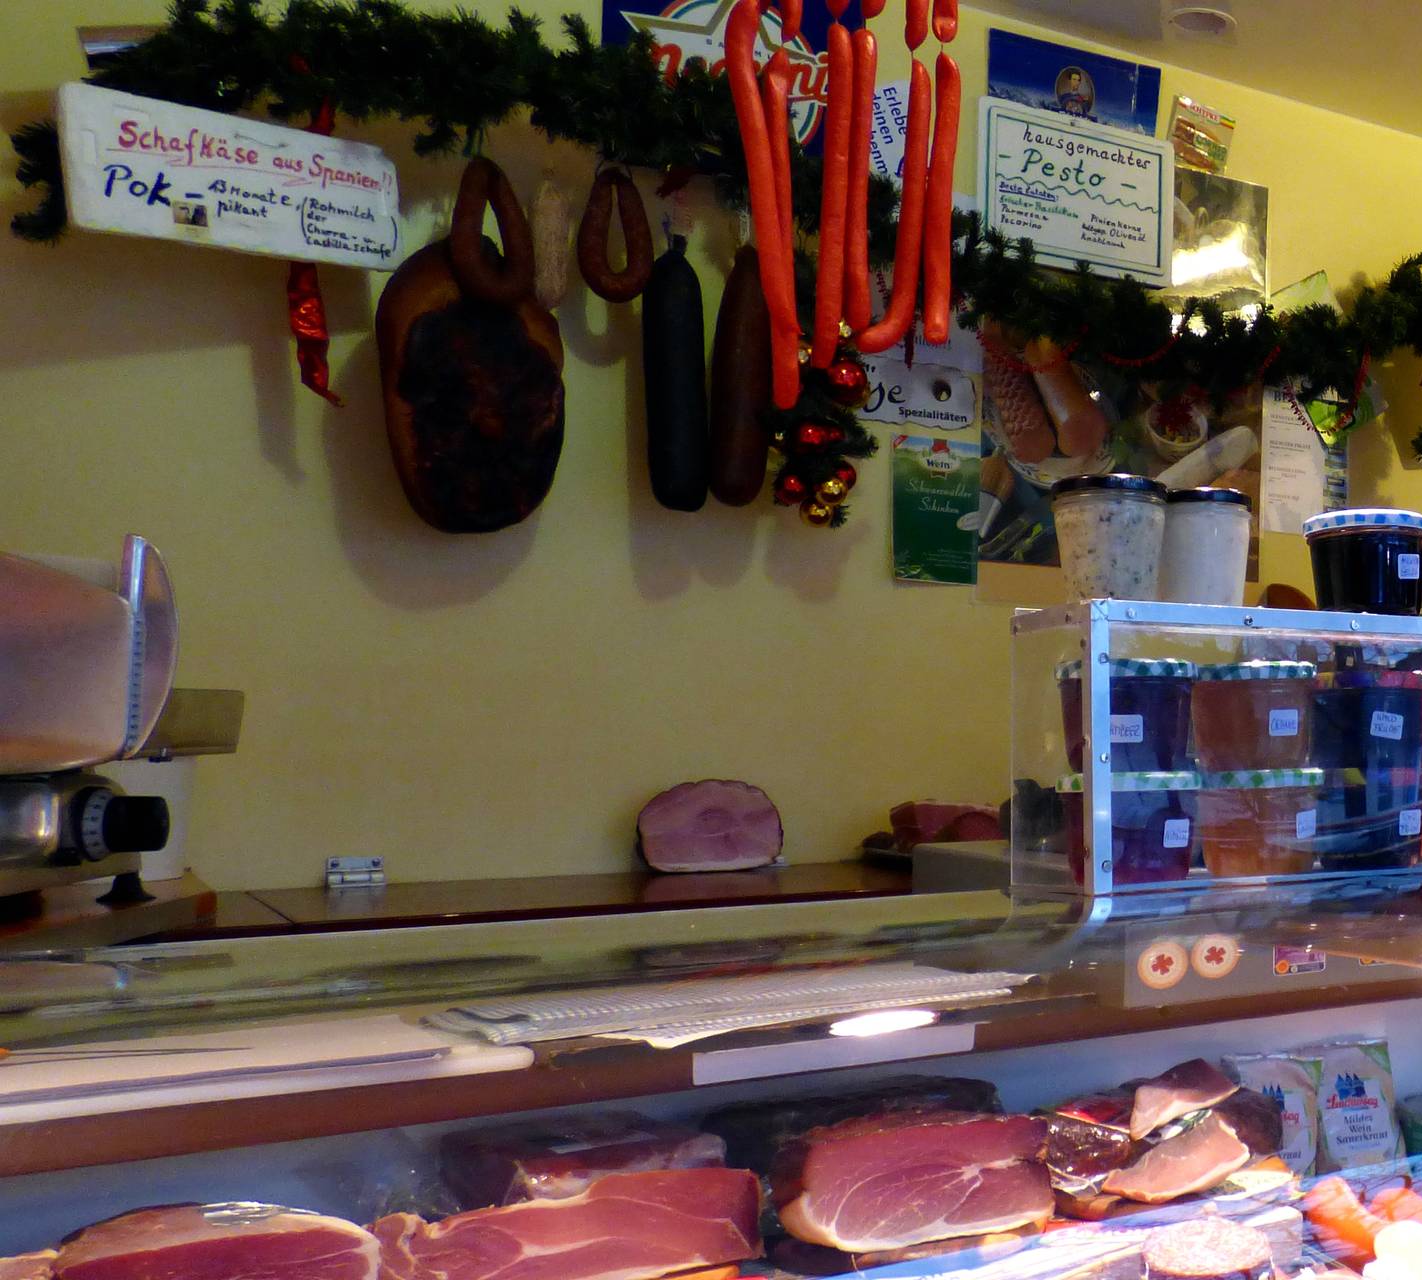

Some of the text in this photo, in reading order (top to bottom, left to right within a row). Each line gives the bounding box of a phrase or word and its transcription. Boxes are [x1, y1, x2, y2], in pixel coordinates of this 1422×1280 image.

[883, 86, 907, 135] Erlebe
[273, 154, 304, 174] aus
[1021, 147, 1106, 187] Pesto
[104, 164, 172, 206] Pok
[898, 405, 968, 424] Spezialitäten
[1336, 1131, 1389, 1146] Sauerkraut
[1349, 1123, 1372, 1134] Wein
